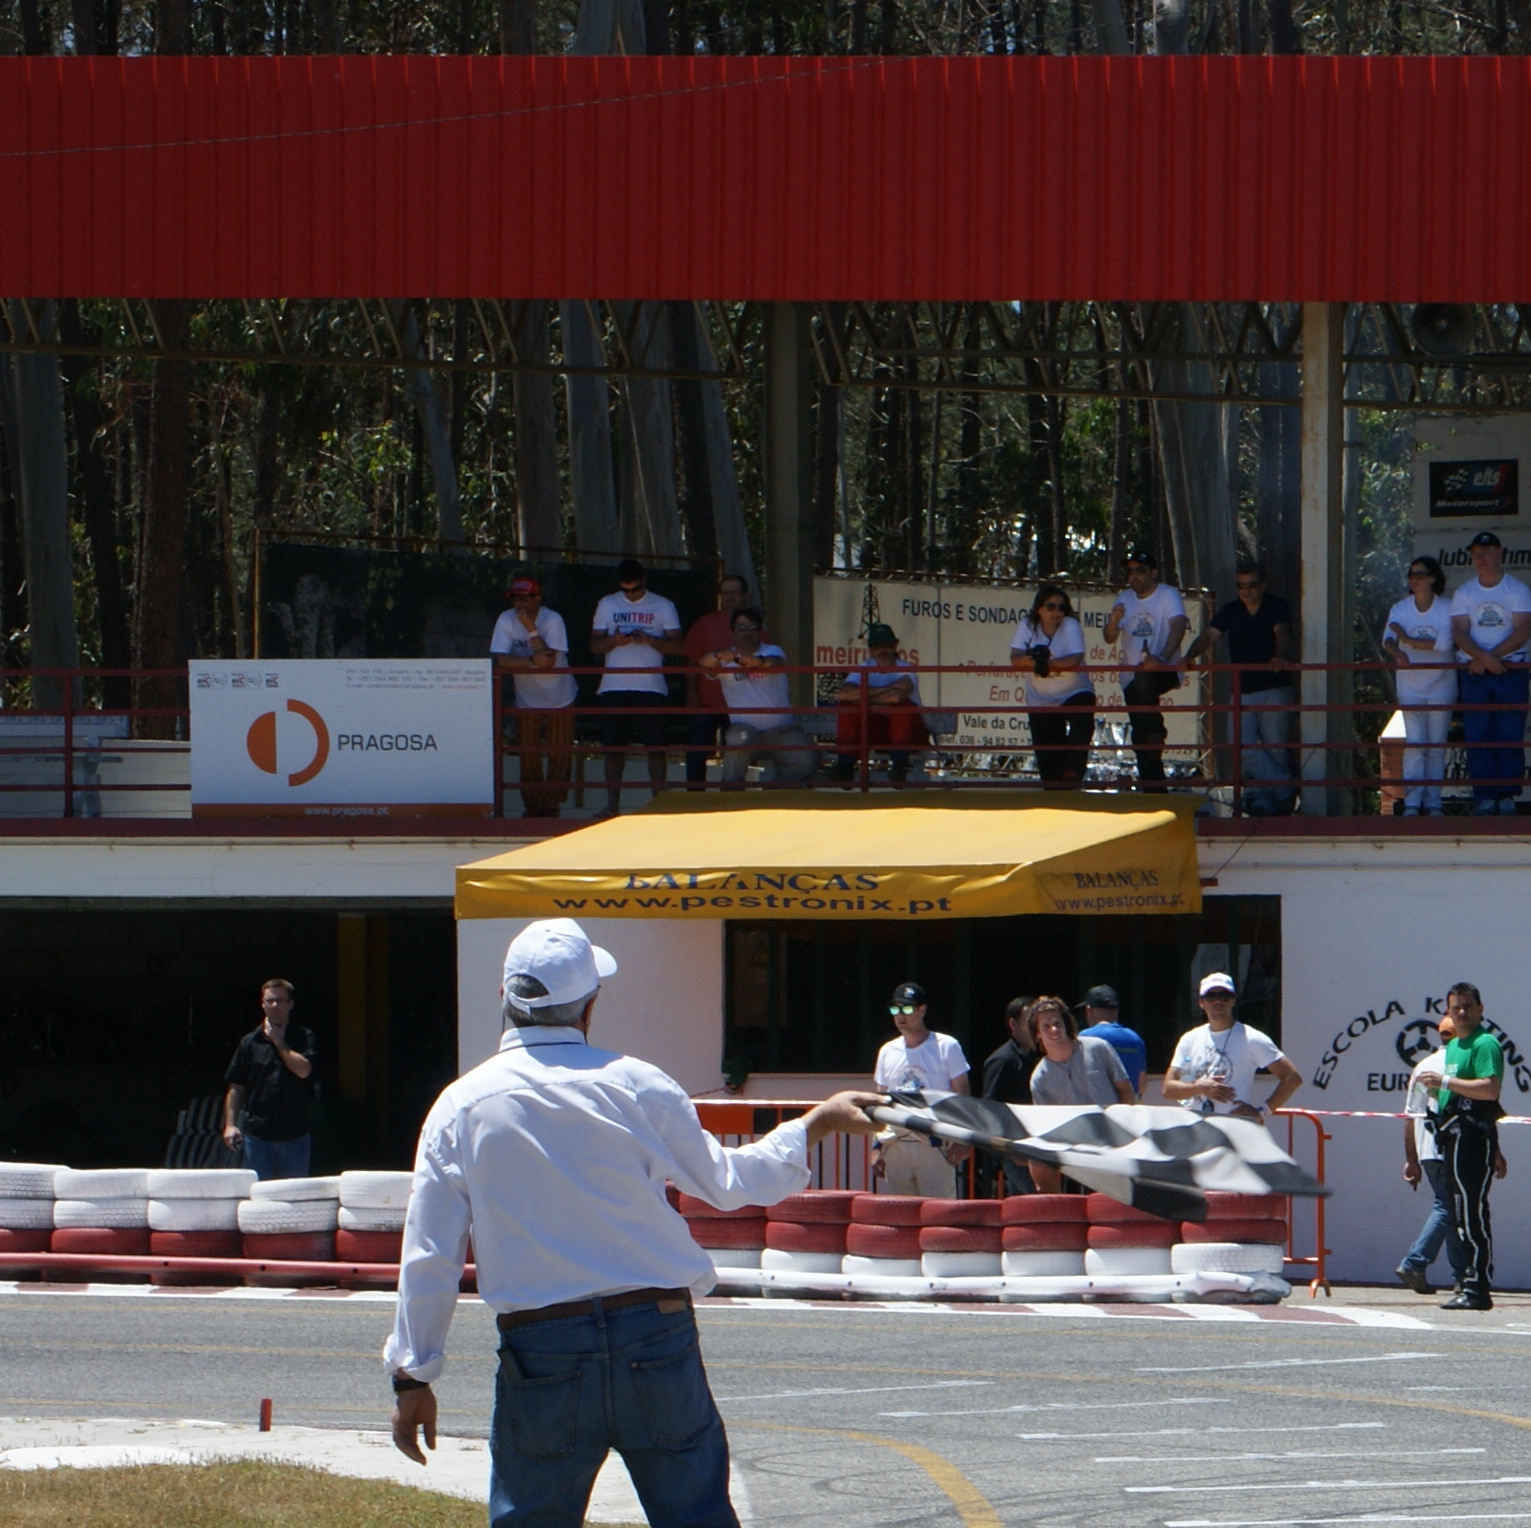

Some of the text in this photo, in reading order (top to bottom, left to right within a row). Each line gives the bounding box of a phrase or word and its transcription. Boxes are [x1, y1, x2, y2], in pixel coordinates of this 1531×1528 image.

[613, 612, 655, 624] UNITRIP
[902, 598, 951, 620] FUROS
[955, 603, 964, 621] E
[963, 714, 1031, 731] Vale da Cru
[337, 734, 438, 751] PRAGOSA
[305, 805, 390, 818] www.pragosa.pt
[1074, 869, 1160, 891] BALANÇAS
[552, 893, 953, 916] www.pestronix.pt
[1313, 1000, 1405, 1090] ESCOLA
